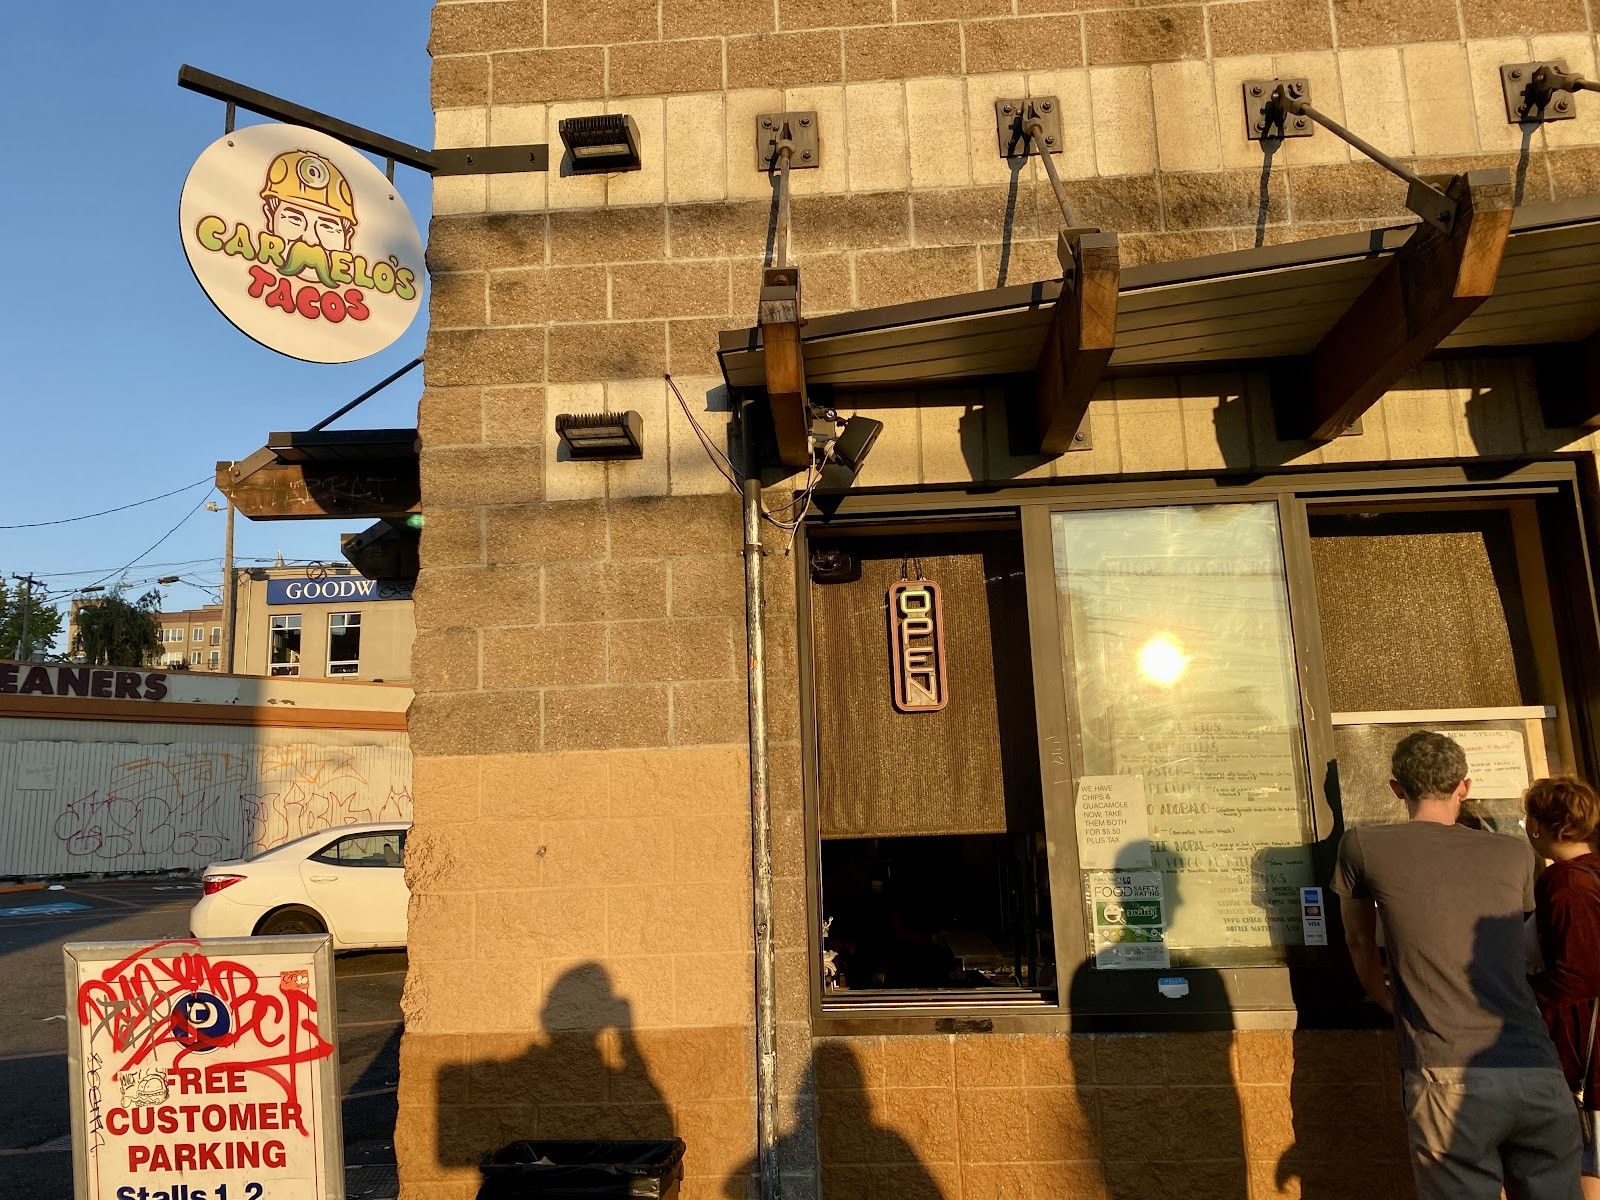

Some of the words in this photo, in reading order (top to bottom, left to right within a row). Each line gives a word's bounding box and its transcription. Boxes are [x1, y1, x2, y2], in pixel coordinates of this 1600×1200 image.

[196, 215, 417, 301] CARMELO'S
[248, 265, 370, 323] TACOS
[900, 589, 936, 702] OPEN
[1094, 886, 1133, 897] FOOD
[1127, 909, 1158, 917] EXCELLENT
[167, 1067, 248, 1095] FREE
[105, 1102, 303, 1136] CUSTOMER
[128, 1140, 287, 1173] PARKING
